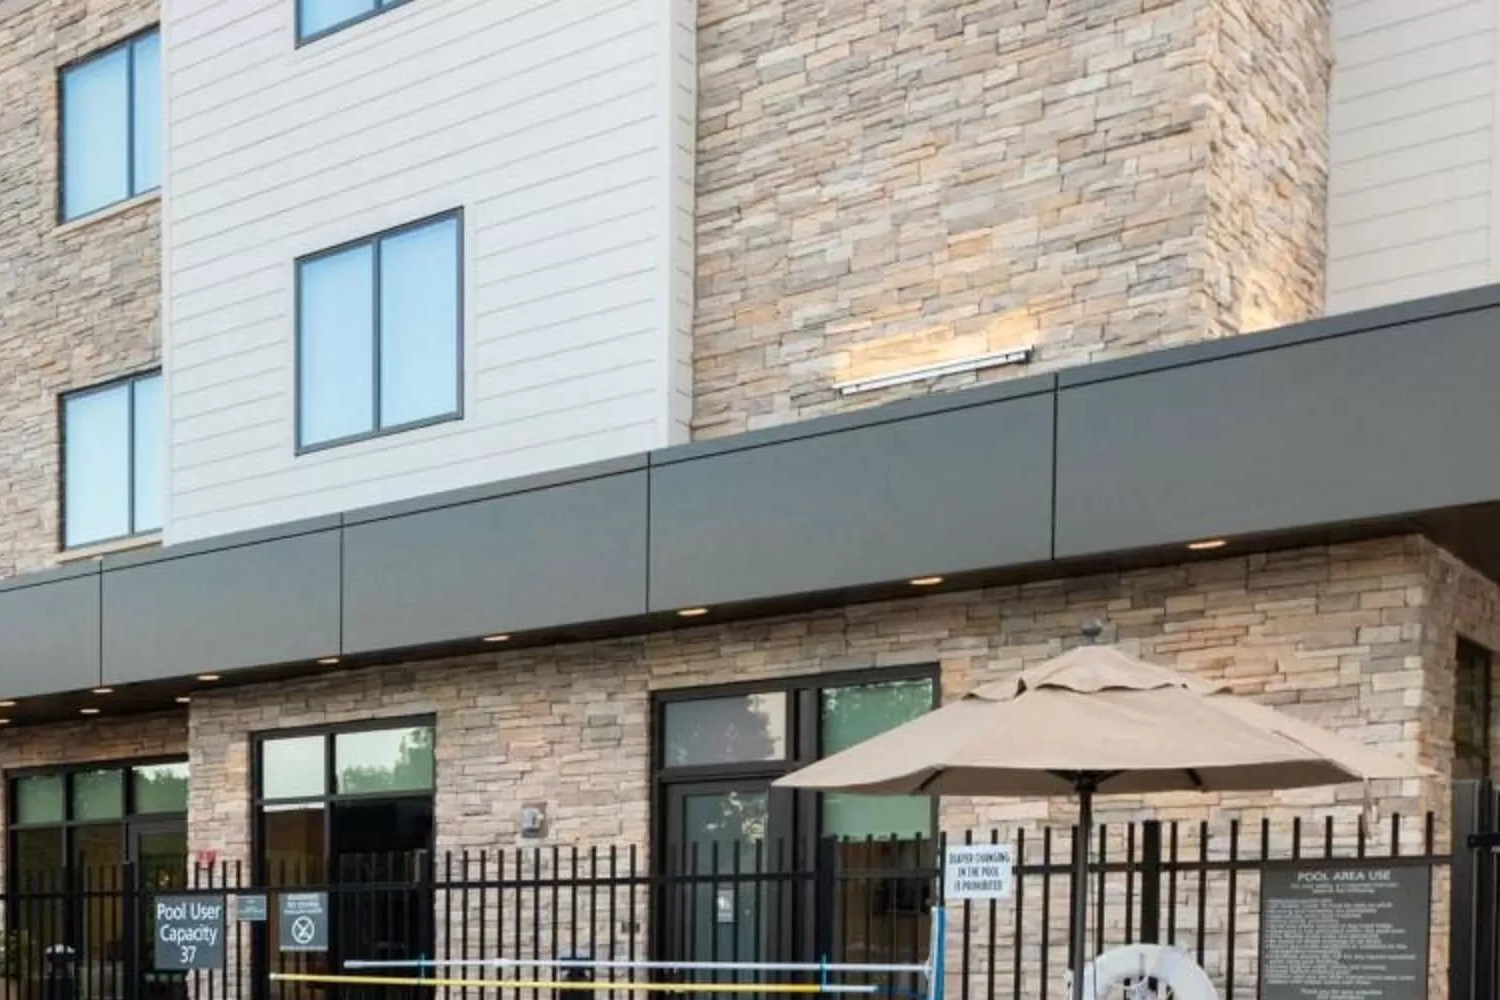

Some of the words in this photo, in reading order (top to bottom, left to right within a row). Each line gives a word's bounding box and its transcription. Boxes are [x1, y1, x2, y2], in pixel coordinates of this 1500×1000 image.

[1298, 871, 1329, 882] POOL
[1332, 870, 1366, 881] AREA
[1367, 869, 1391, 881] USE
[157, 902, 187, 920] Pool
[190, 902, 221, 920] User
[160, 923, 218, 947] Capacity
[180, 945, 197, 964] 37
